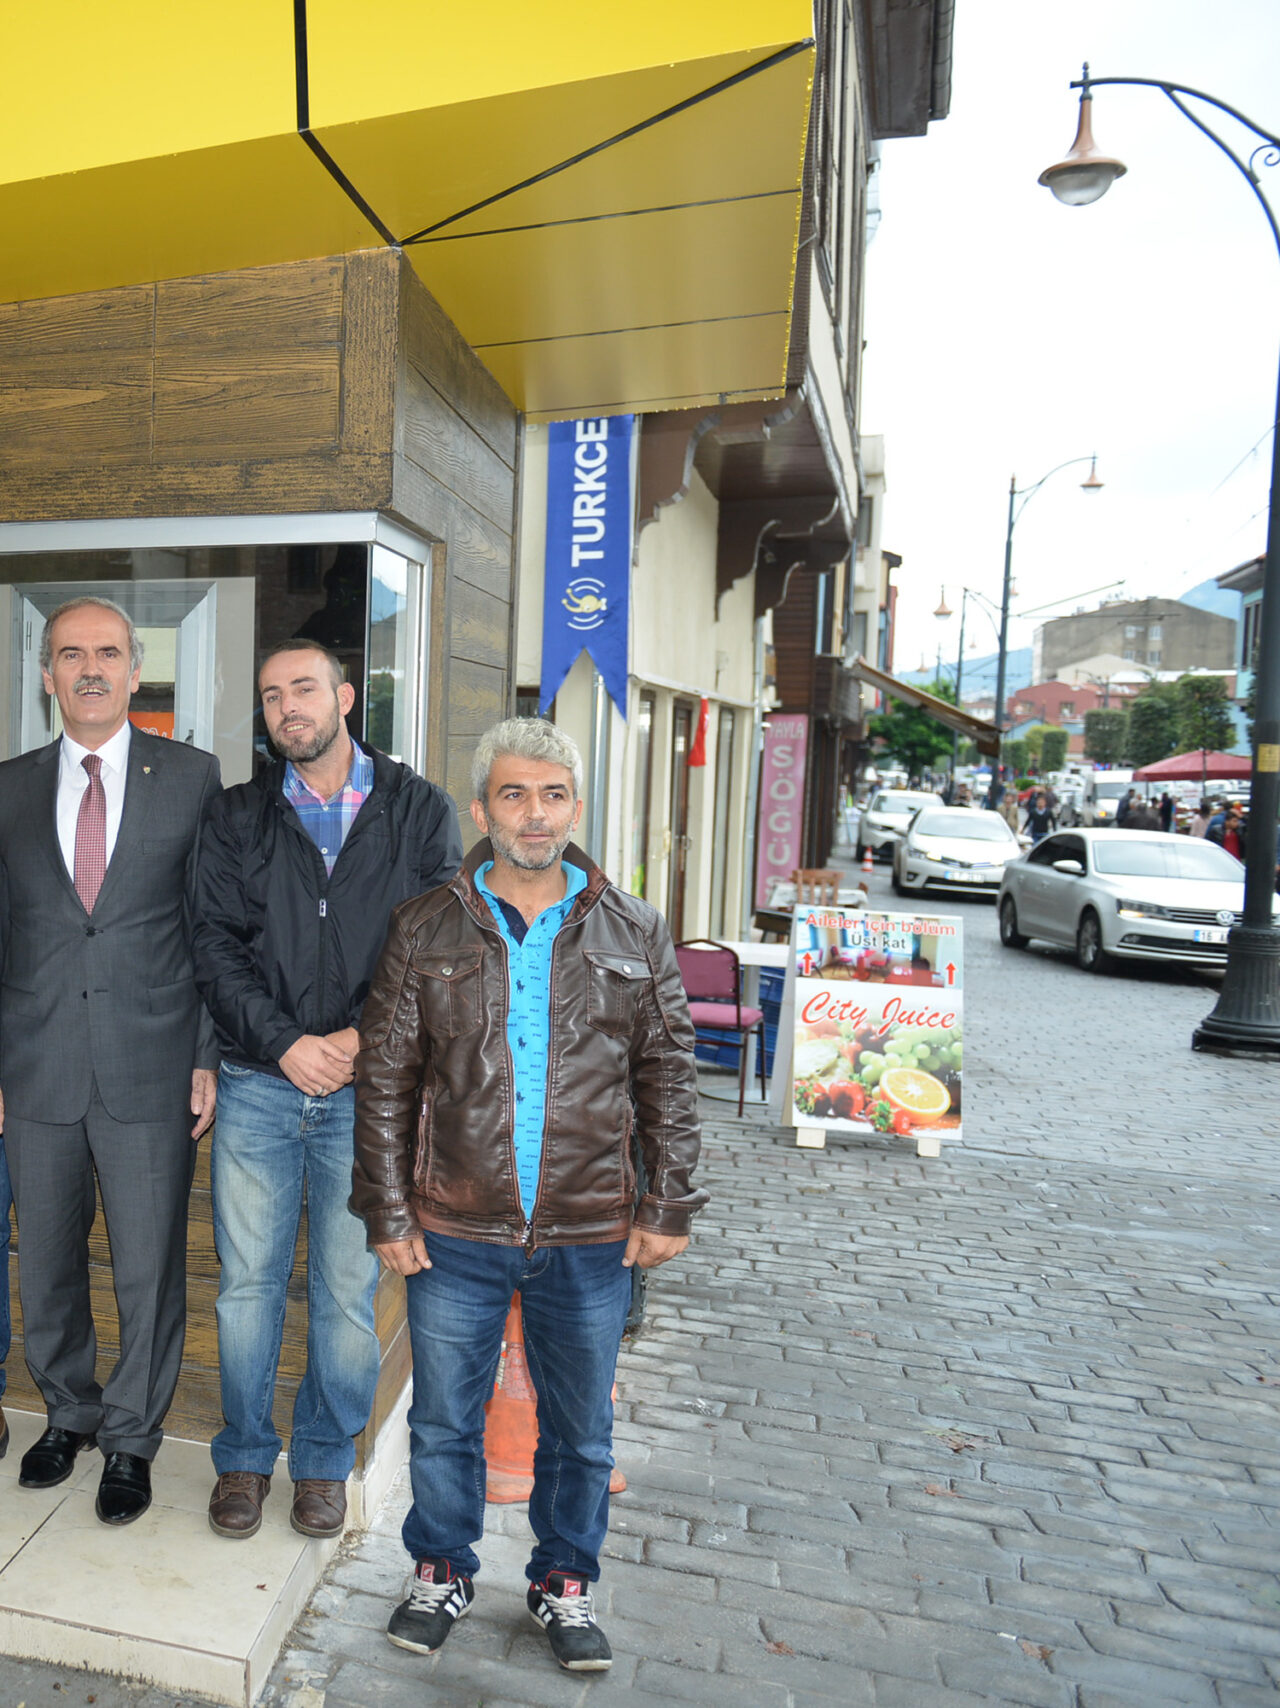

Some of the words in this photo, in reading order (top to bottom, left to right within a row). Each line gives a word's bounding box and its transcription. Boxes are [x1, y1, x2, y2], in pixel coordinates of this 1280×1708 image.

[571, 418, 609, 567] TURKCE
[805, 913, 860, 930] Aileler
[864, 917, 896, 933] için
[901, 920, 956, 936] bölüm
[851, 934, 878, 947] Üst
[883, 936, 906, 949] kat
[801, 991, 868, 1029] City
[878, 997, 956, 1035] Juice
